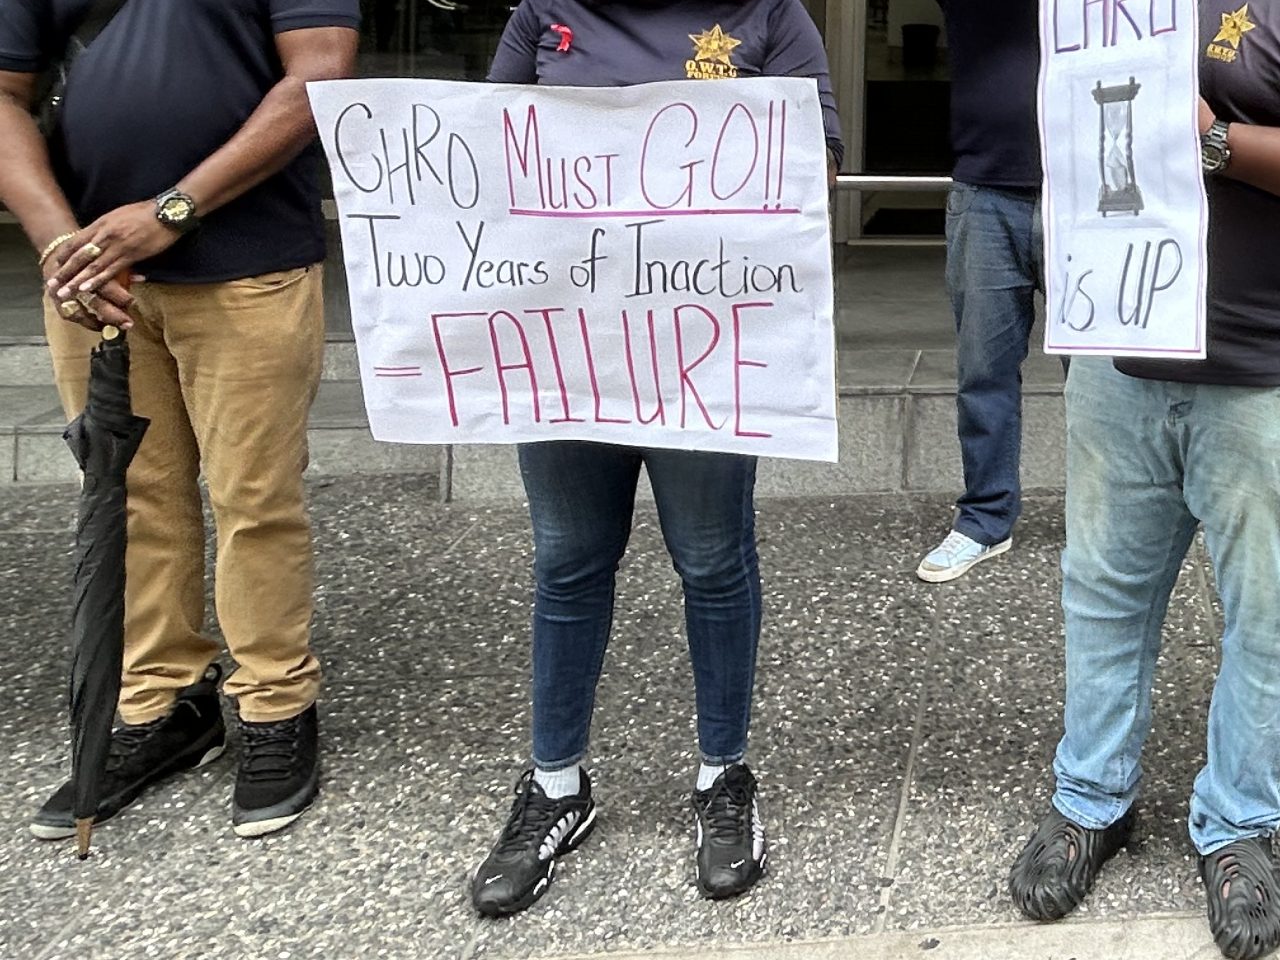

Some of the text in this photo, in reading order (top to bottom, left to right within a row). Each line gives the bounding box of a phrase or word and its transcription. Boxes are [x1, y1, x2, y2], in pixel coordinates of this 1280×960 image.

[335, 102, 479, 209] CHRO
[640, 100, 787, 211] GO!!
[347, 214, 804, 299] Two Years of Inaction
[1057, 238, 1183, 332] is UP
[431, 303, 774, 437] FAILURE
